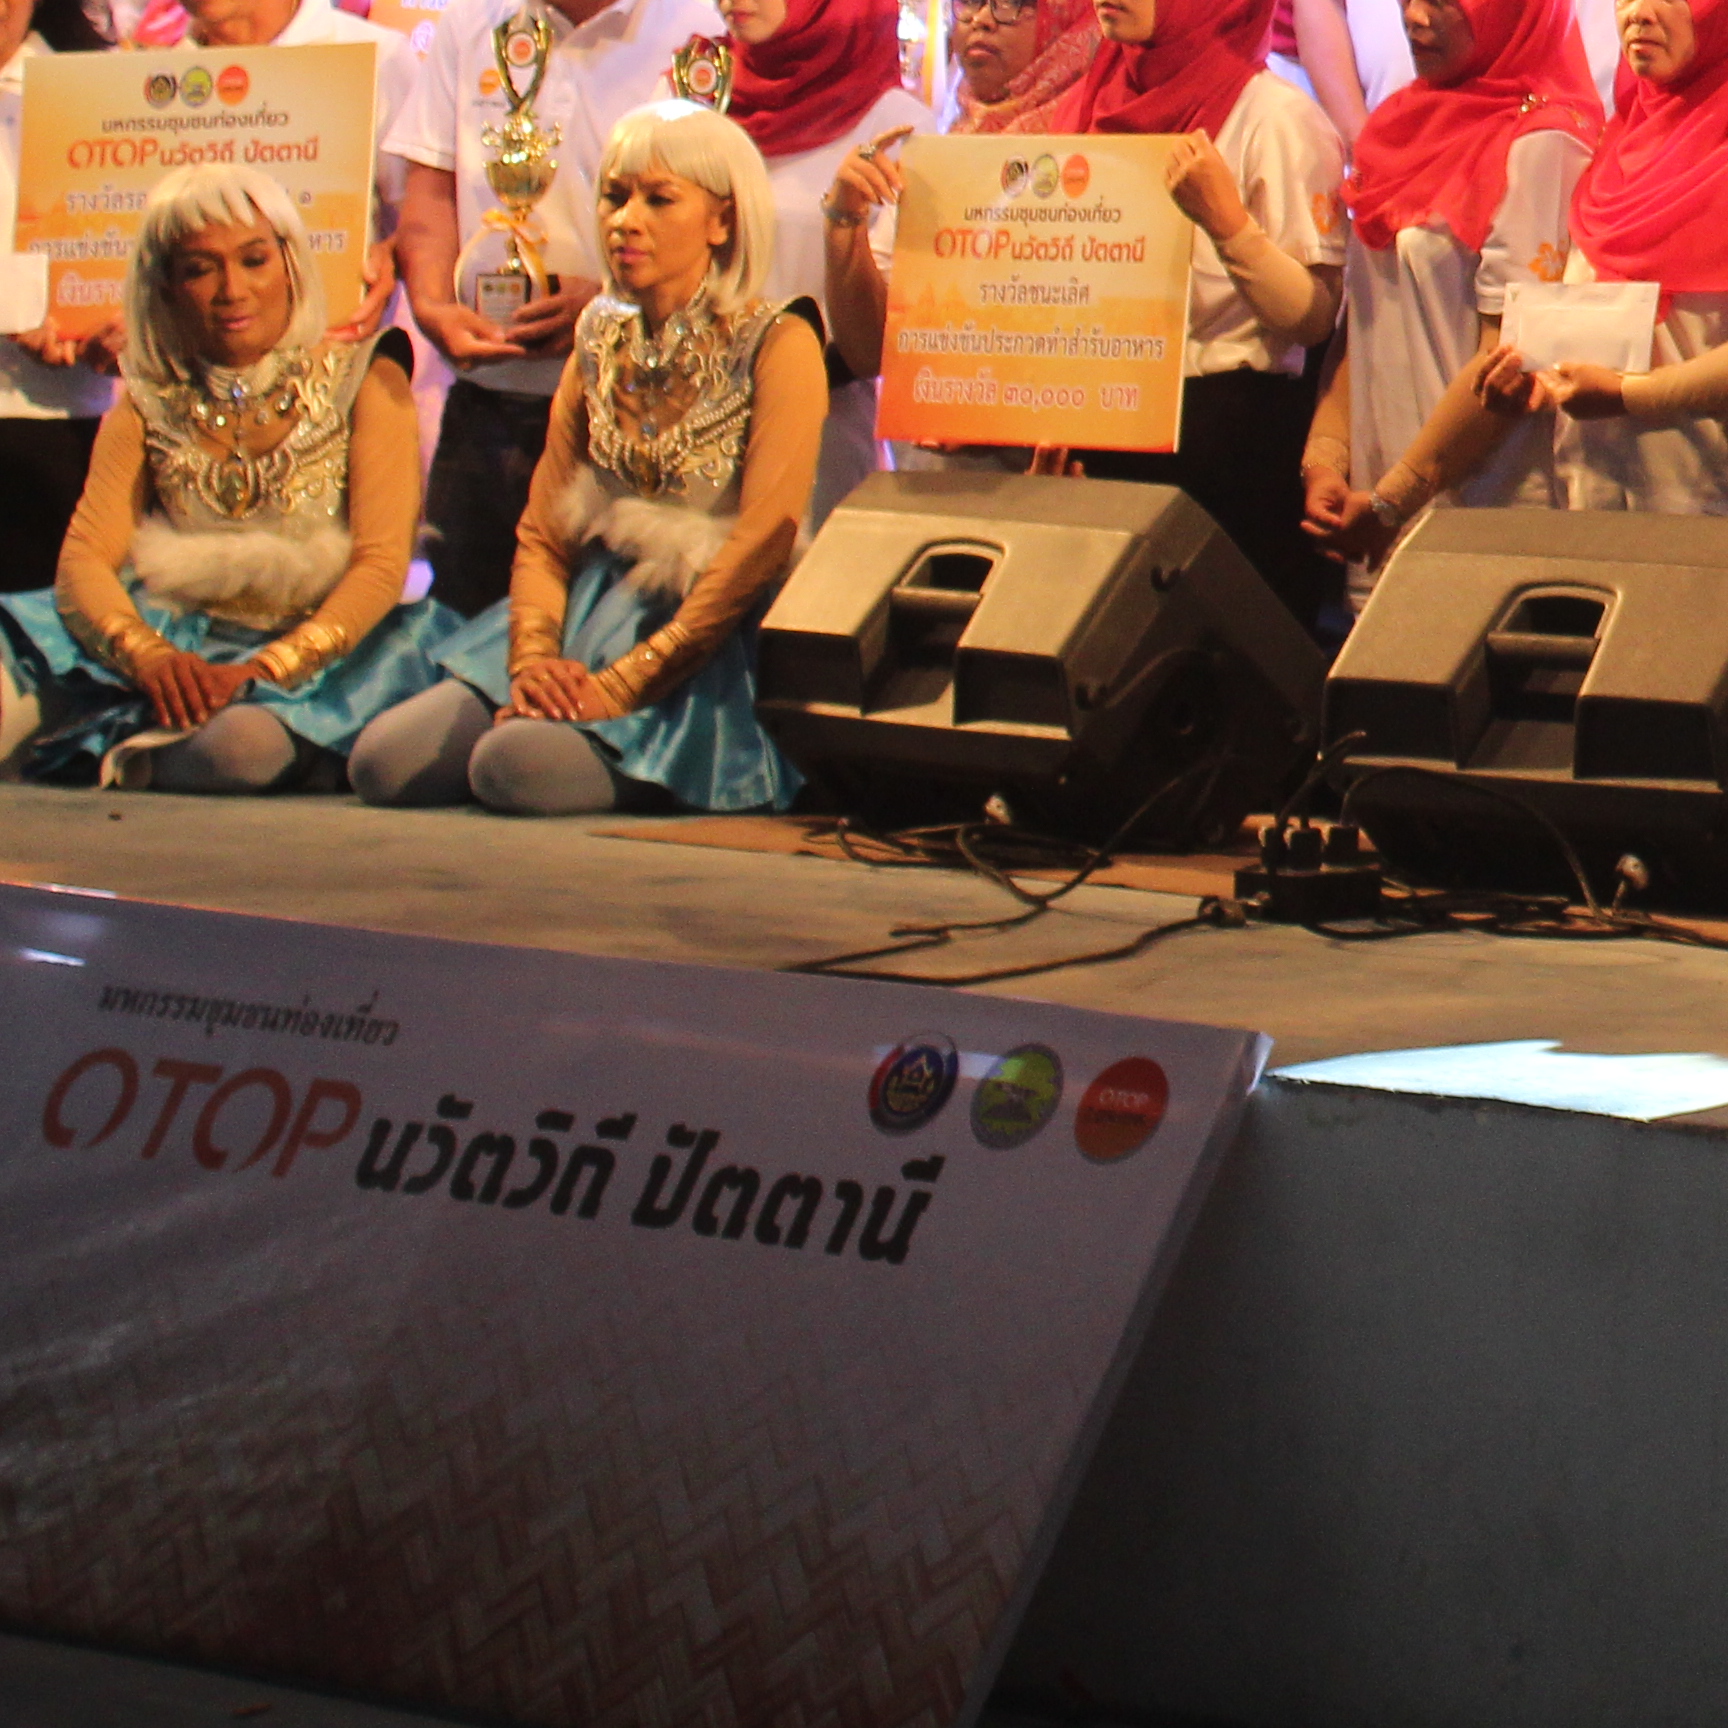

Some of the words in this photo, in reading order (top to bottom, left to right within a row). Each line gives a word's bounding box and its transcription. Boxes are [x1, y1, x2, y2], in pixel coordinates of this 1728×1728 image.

[102, 103, 288, 134] มหกรรมชุมชนท่องเที่ยว
[66, 138, 158, 168] OTOP
[244, 135, 319, 162] ปัตตานี
[964, 196, 1121, 226] มหกรรมชุมชนท่องเที่ยว
[934, 227, 1010, 260] OTOP
[1082, 235, 1146, 263] ปัตตานี
[979, 275, 1090, 304] รางวัลชนะเลิศ
[914, 369, 997, 403] เงินรางวัล
[1100, 385, 1139, 410] บาท
[98, 985, 399, 1046] มหกรรมชุมชนท่องเที่ยว
[42, 1047, 362, 1178] OTOP
[354, 1093, 637, 1220] นวัตวิถี
[630, 1122, 946, 1265] ปัตตานี
